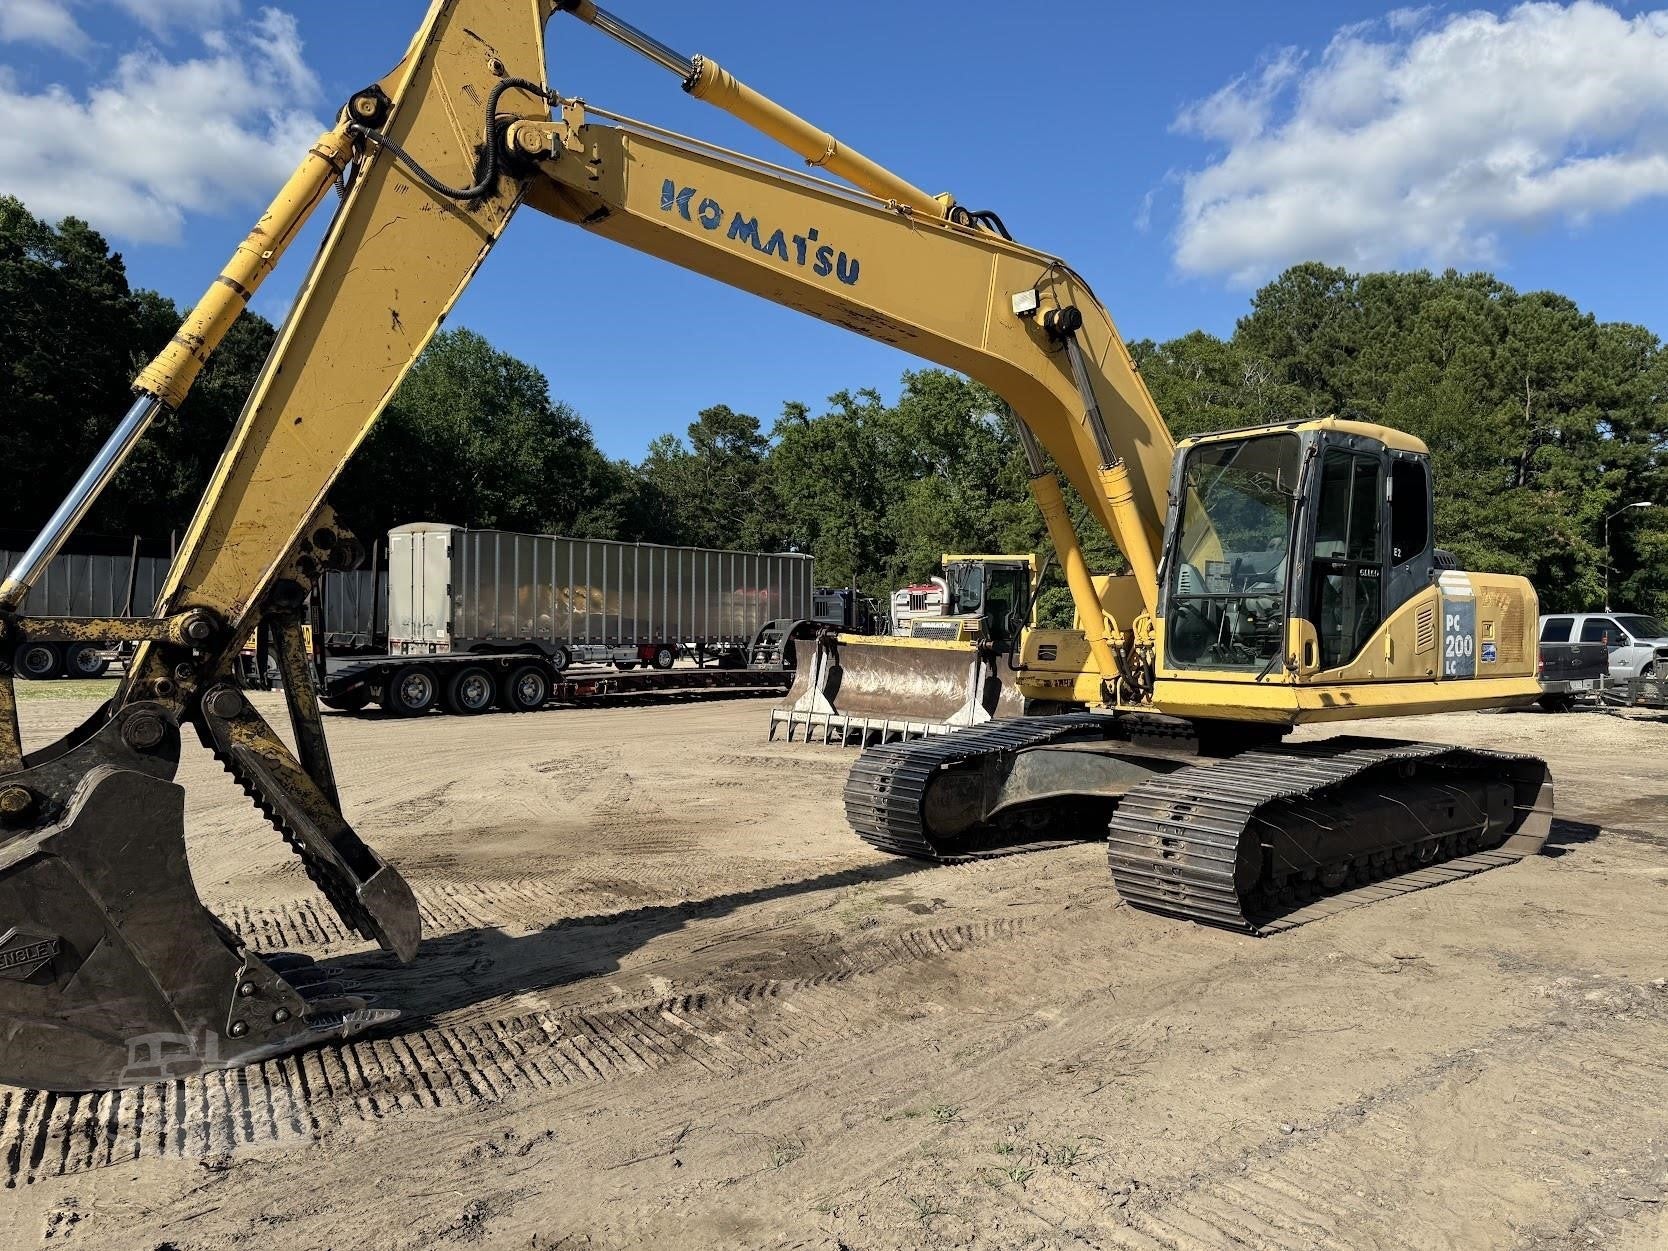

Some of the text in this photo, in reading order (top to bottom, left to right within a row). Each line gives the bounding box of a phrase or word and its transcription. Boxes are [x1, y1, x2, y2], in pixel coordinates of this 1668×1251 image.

[660, 178, 860, 286] KOMATSU
[1446, 614, 1460, 632] PC
[1446, 634, 1473, 658] 200
[1446, 660, 1457, 675] LC
